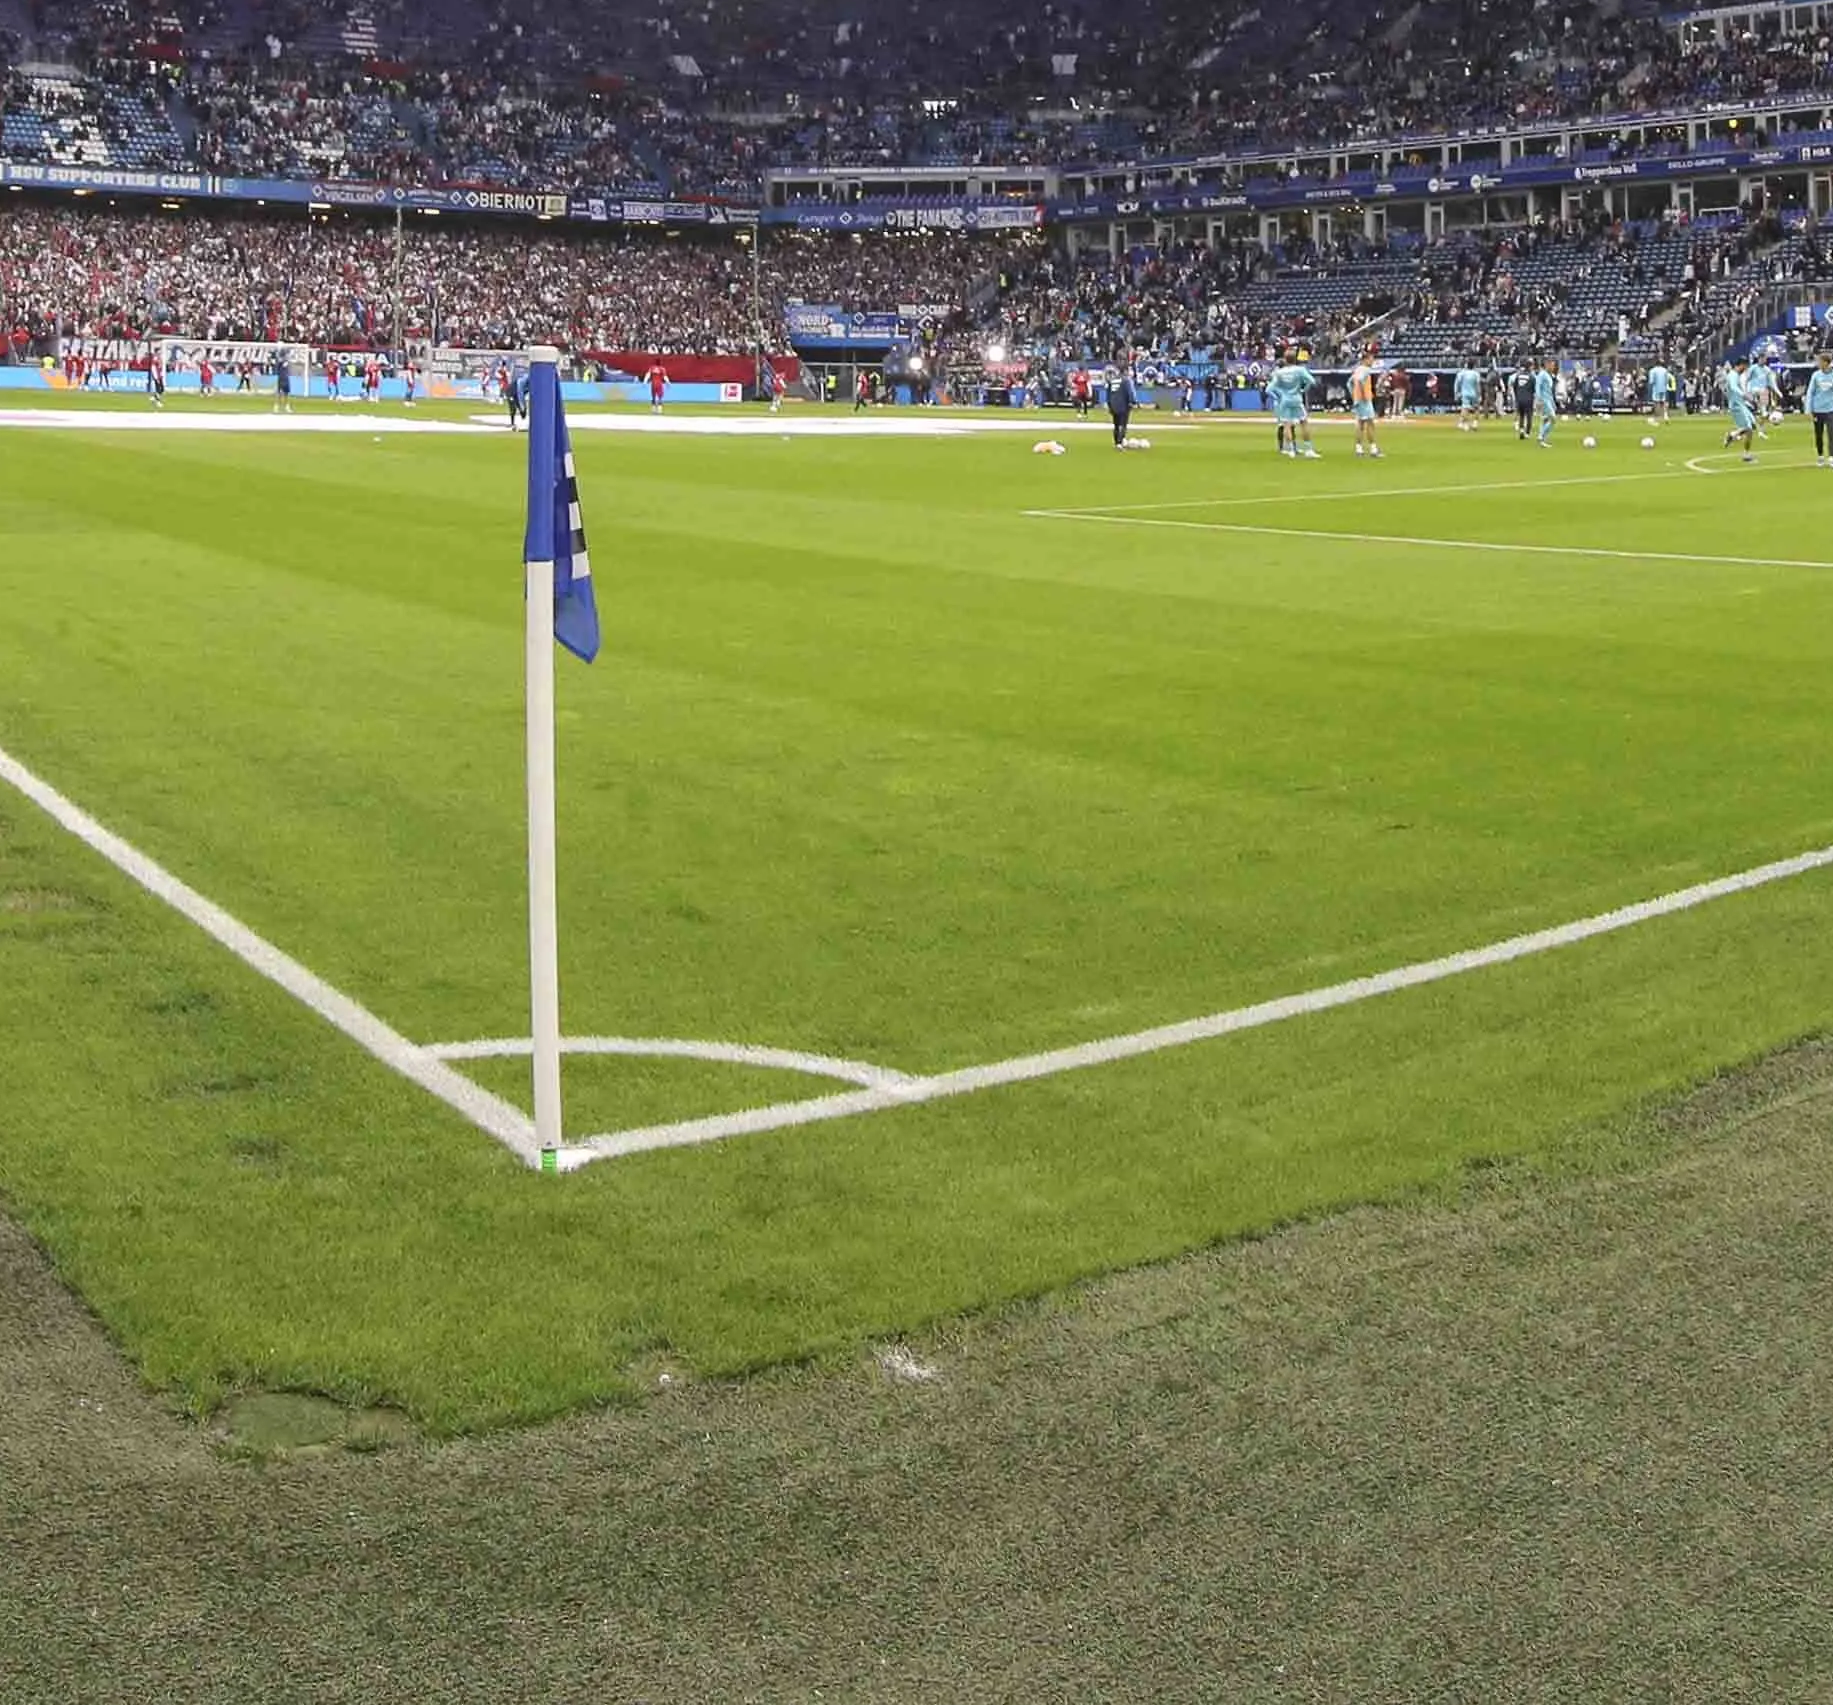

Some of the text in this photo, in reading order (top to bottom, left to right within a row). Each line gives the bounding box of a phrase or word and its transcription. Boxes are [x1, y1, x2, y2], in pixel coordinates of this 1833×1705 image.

[10, 164, 202, 192] HSV SUPPORTERS CLUB
[479, 193, 545, 211] BIERNOT
